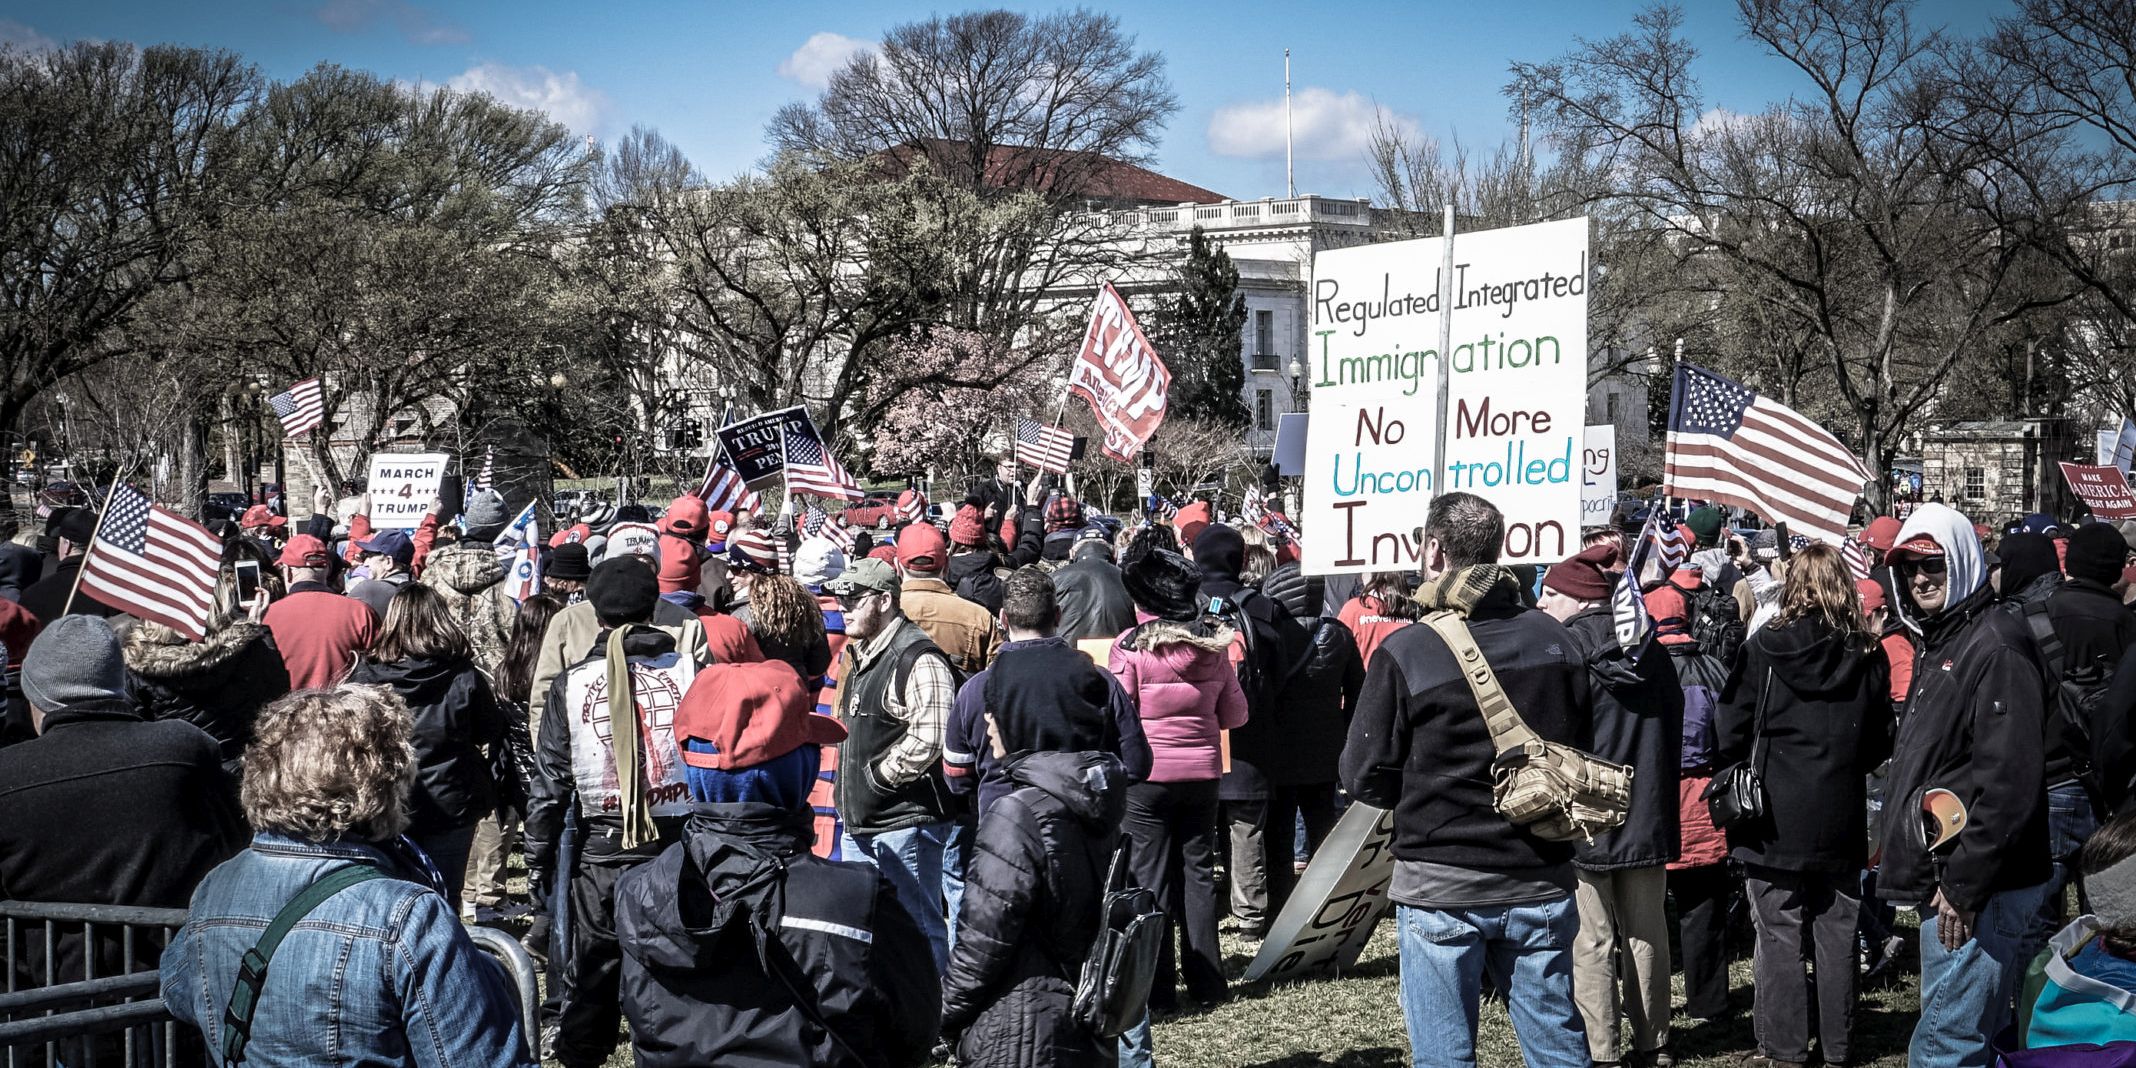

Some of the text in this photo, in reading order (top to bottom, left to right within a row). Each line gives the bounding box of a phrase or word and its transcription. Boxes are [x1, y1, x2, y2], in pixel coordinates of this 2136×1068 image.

[1315, 250, 1585, 337] Regulated Integrated
[1355, 396, 1551, 447] No More
[731, 420, 803, 451] TRUMP
[765, 442, 781, 451] 201
[754, 452, 784, 470] PEN
[380, 468, 434, 479] MARCH
[2080, 473, 2103, 482] MAKE
[397, 483, 413, 499] 4
[2072, 482, 2131, 498] AMERICA
[377, 503, 428, 514] TRUMP
[2105, 498, 2134, 509] AGAIN
[1333, 500, 1565, 566] Invon
[1269, 889, 1366, 975] Die
